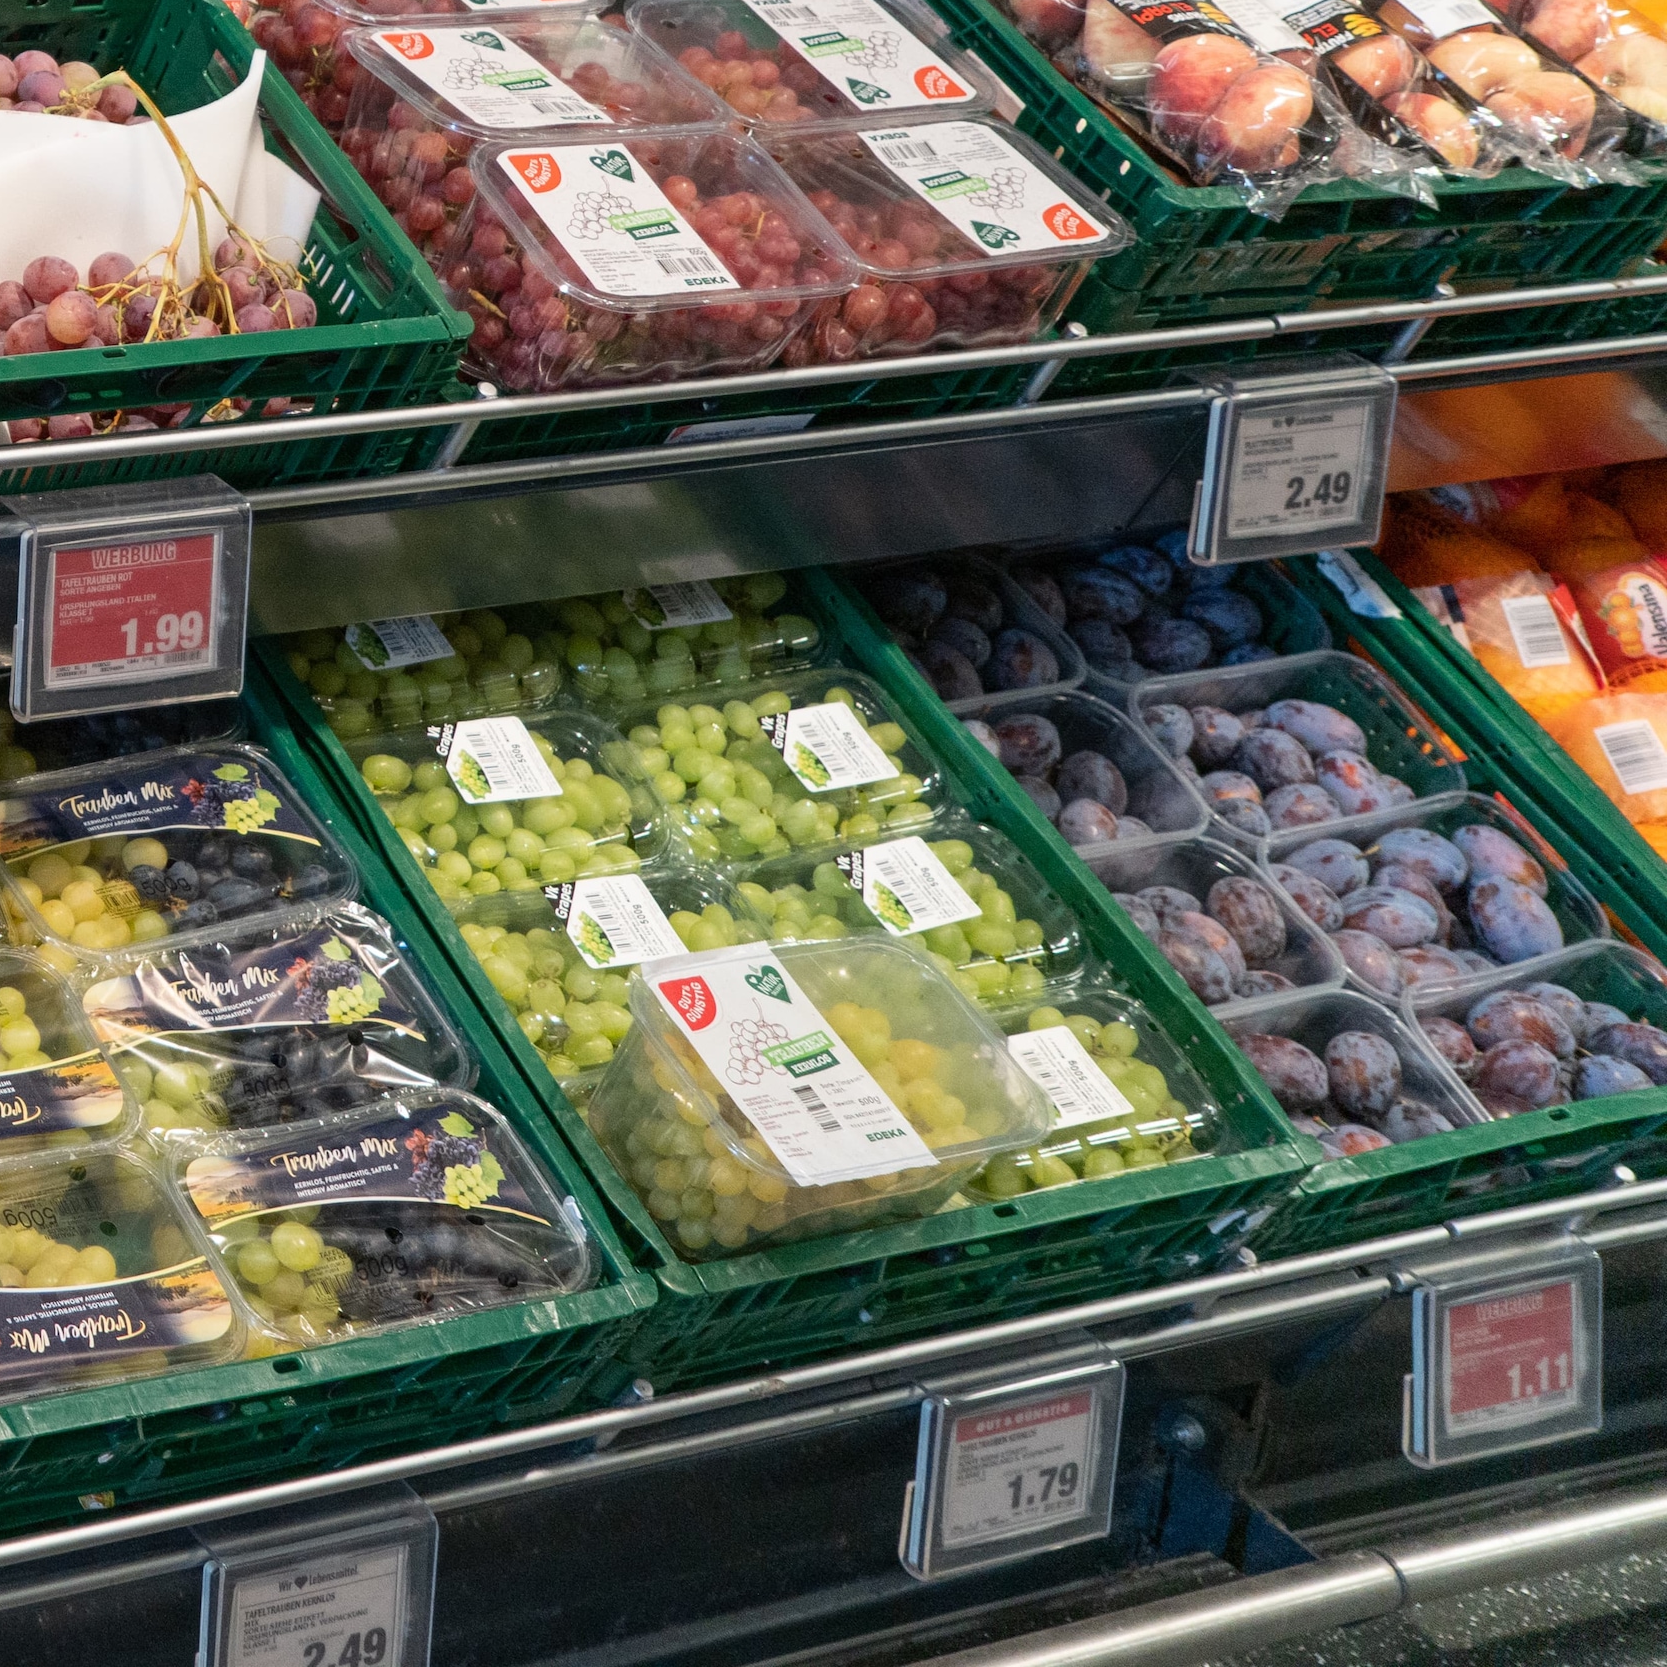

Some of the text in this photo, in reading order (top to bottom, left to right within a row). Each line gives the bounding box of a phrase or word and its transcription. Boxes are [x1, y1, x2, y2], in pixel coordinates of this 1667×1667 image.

[684, 275, 729, 287] EDEKA
[1285, 471, 1351, 511] 2.49
[92, 542, 177, 570] WERBUNG
[60, 572, 134, 589] TAFELTRAUBEN ROT
[60, 583, 123, 596] SORTE ANGEBEN
[59, 593, 157, 611] URSPRUNGSLAND ITALIEN
[119, 612, 203, 658] 1.99
[772, 712, 787, 749] Grapes
[58, 781, 175, 819] Trauben Mix
[141, 876, 192, 896] 500g
[241, 965, 280, 988] Mix
[756, 970, 781, 994] NATUR
[685, 981, 702, 1024] GÜNSTIG
[789, 1052, 833, 1075] KERNLOS
[858, 1095, 881, 1107] 500g
[866, 1128, 907, 1143] EDEKA
[270, 1136, 398, 1178] Trauben Mix
[294, 1164, 392, 1189] KERNLOS, FEINFRUCHTIG, SAFTIG
[326, 1178, 367, 1193] AROMATISCH
[3, 1208, 57, 1229] 500g
[9, 1309, 147, 1353] Trauben Mix
[1507, 1352, 1569, 1399] 1.11
[1008, 1462, 1078, 1510] 1.79
[279, 1579, 294, 1594] Wir
[245, 1593, 336, 1620] TAFELTRAUBEN KERNLOS
[303, 1628, 387, 1667] 2.49
